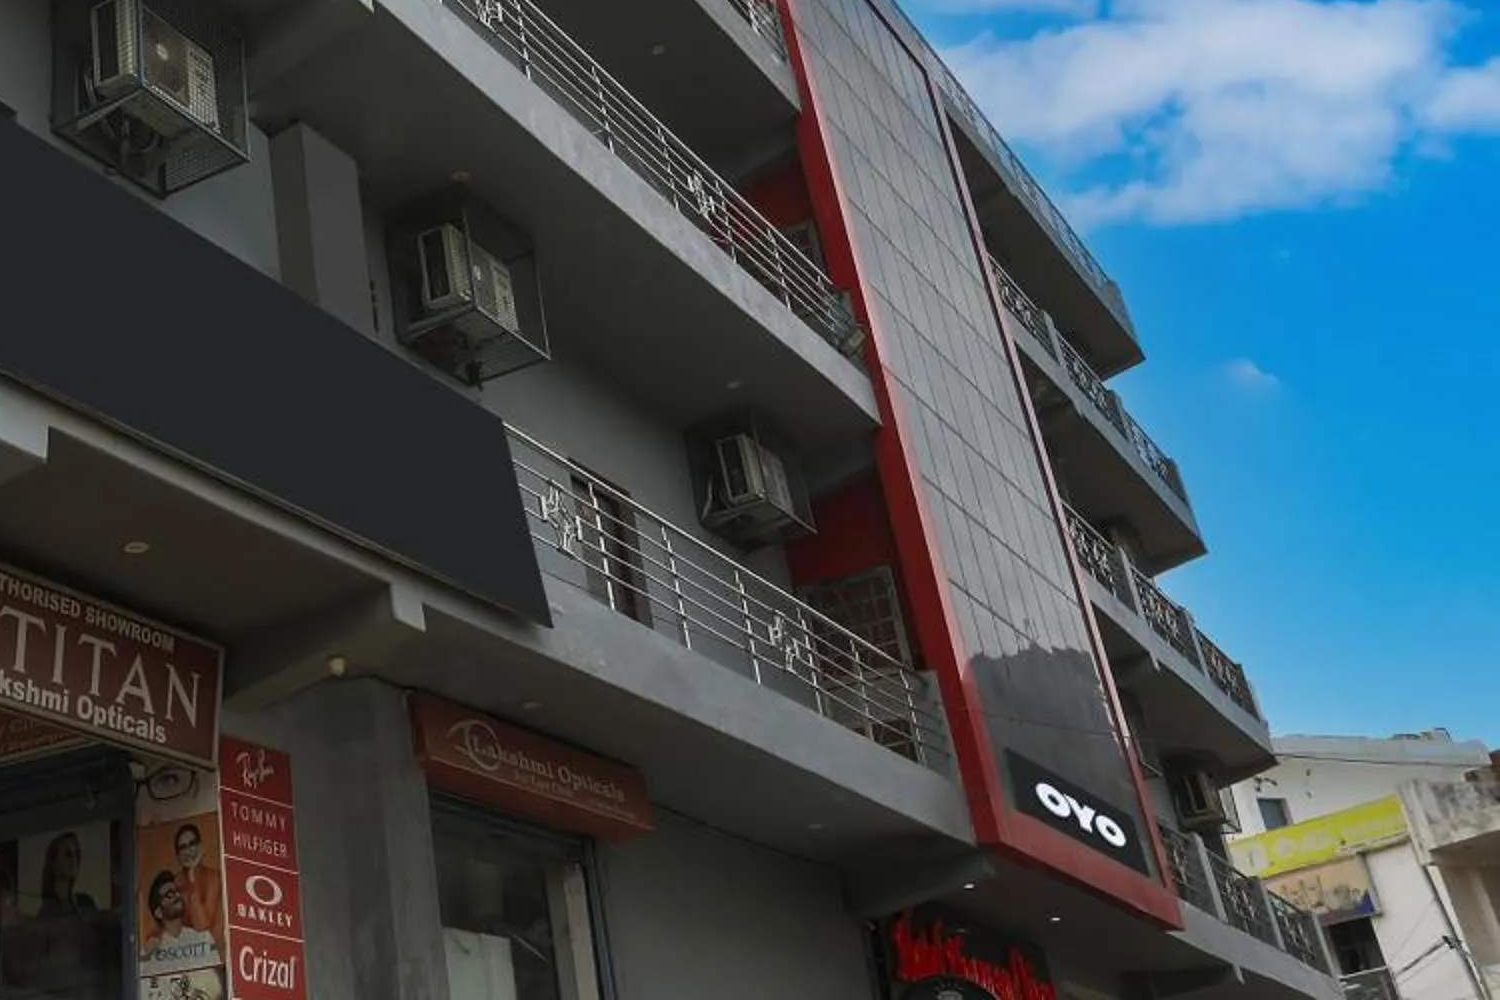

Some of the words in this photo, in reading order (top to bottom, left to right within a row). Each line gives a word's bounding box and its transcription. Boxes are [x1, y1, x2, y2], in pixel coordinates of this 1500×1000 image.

[84, 605, 176, 654] SHOWROOM
[0, 604, 202, 730] TITAN
[76, 694, 168, 745] Opticals
[230, 801, 288, 831] TOMMY
[1035, 782, 1127, 848] OYO
[232, 831, 289, 857] HILFIGER
[236, 902, 294, 929] OAKLEY
[238, 944, 297, 991] Crizal
